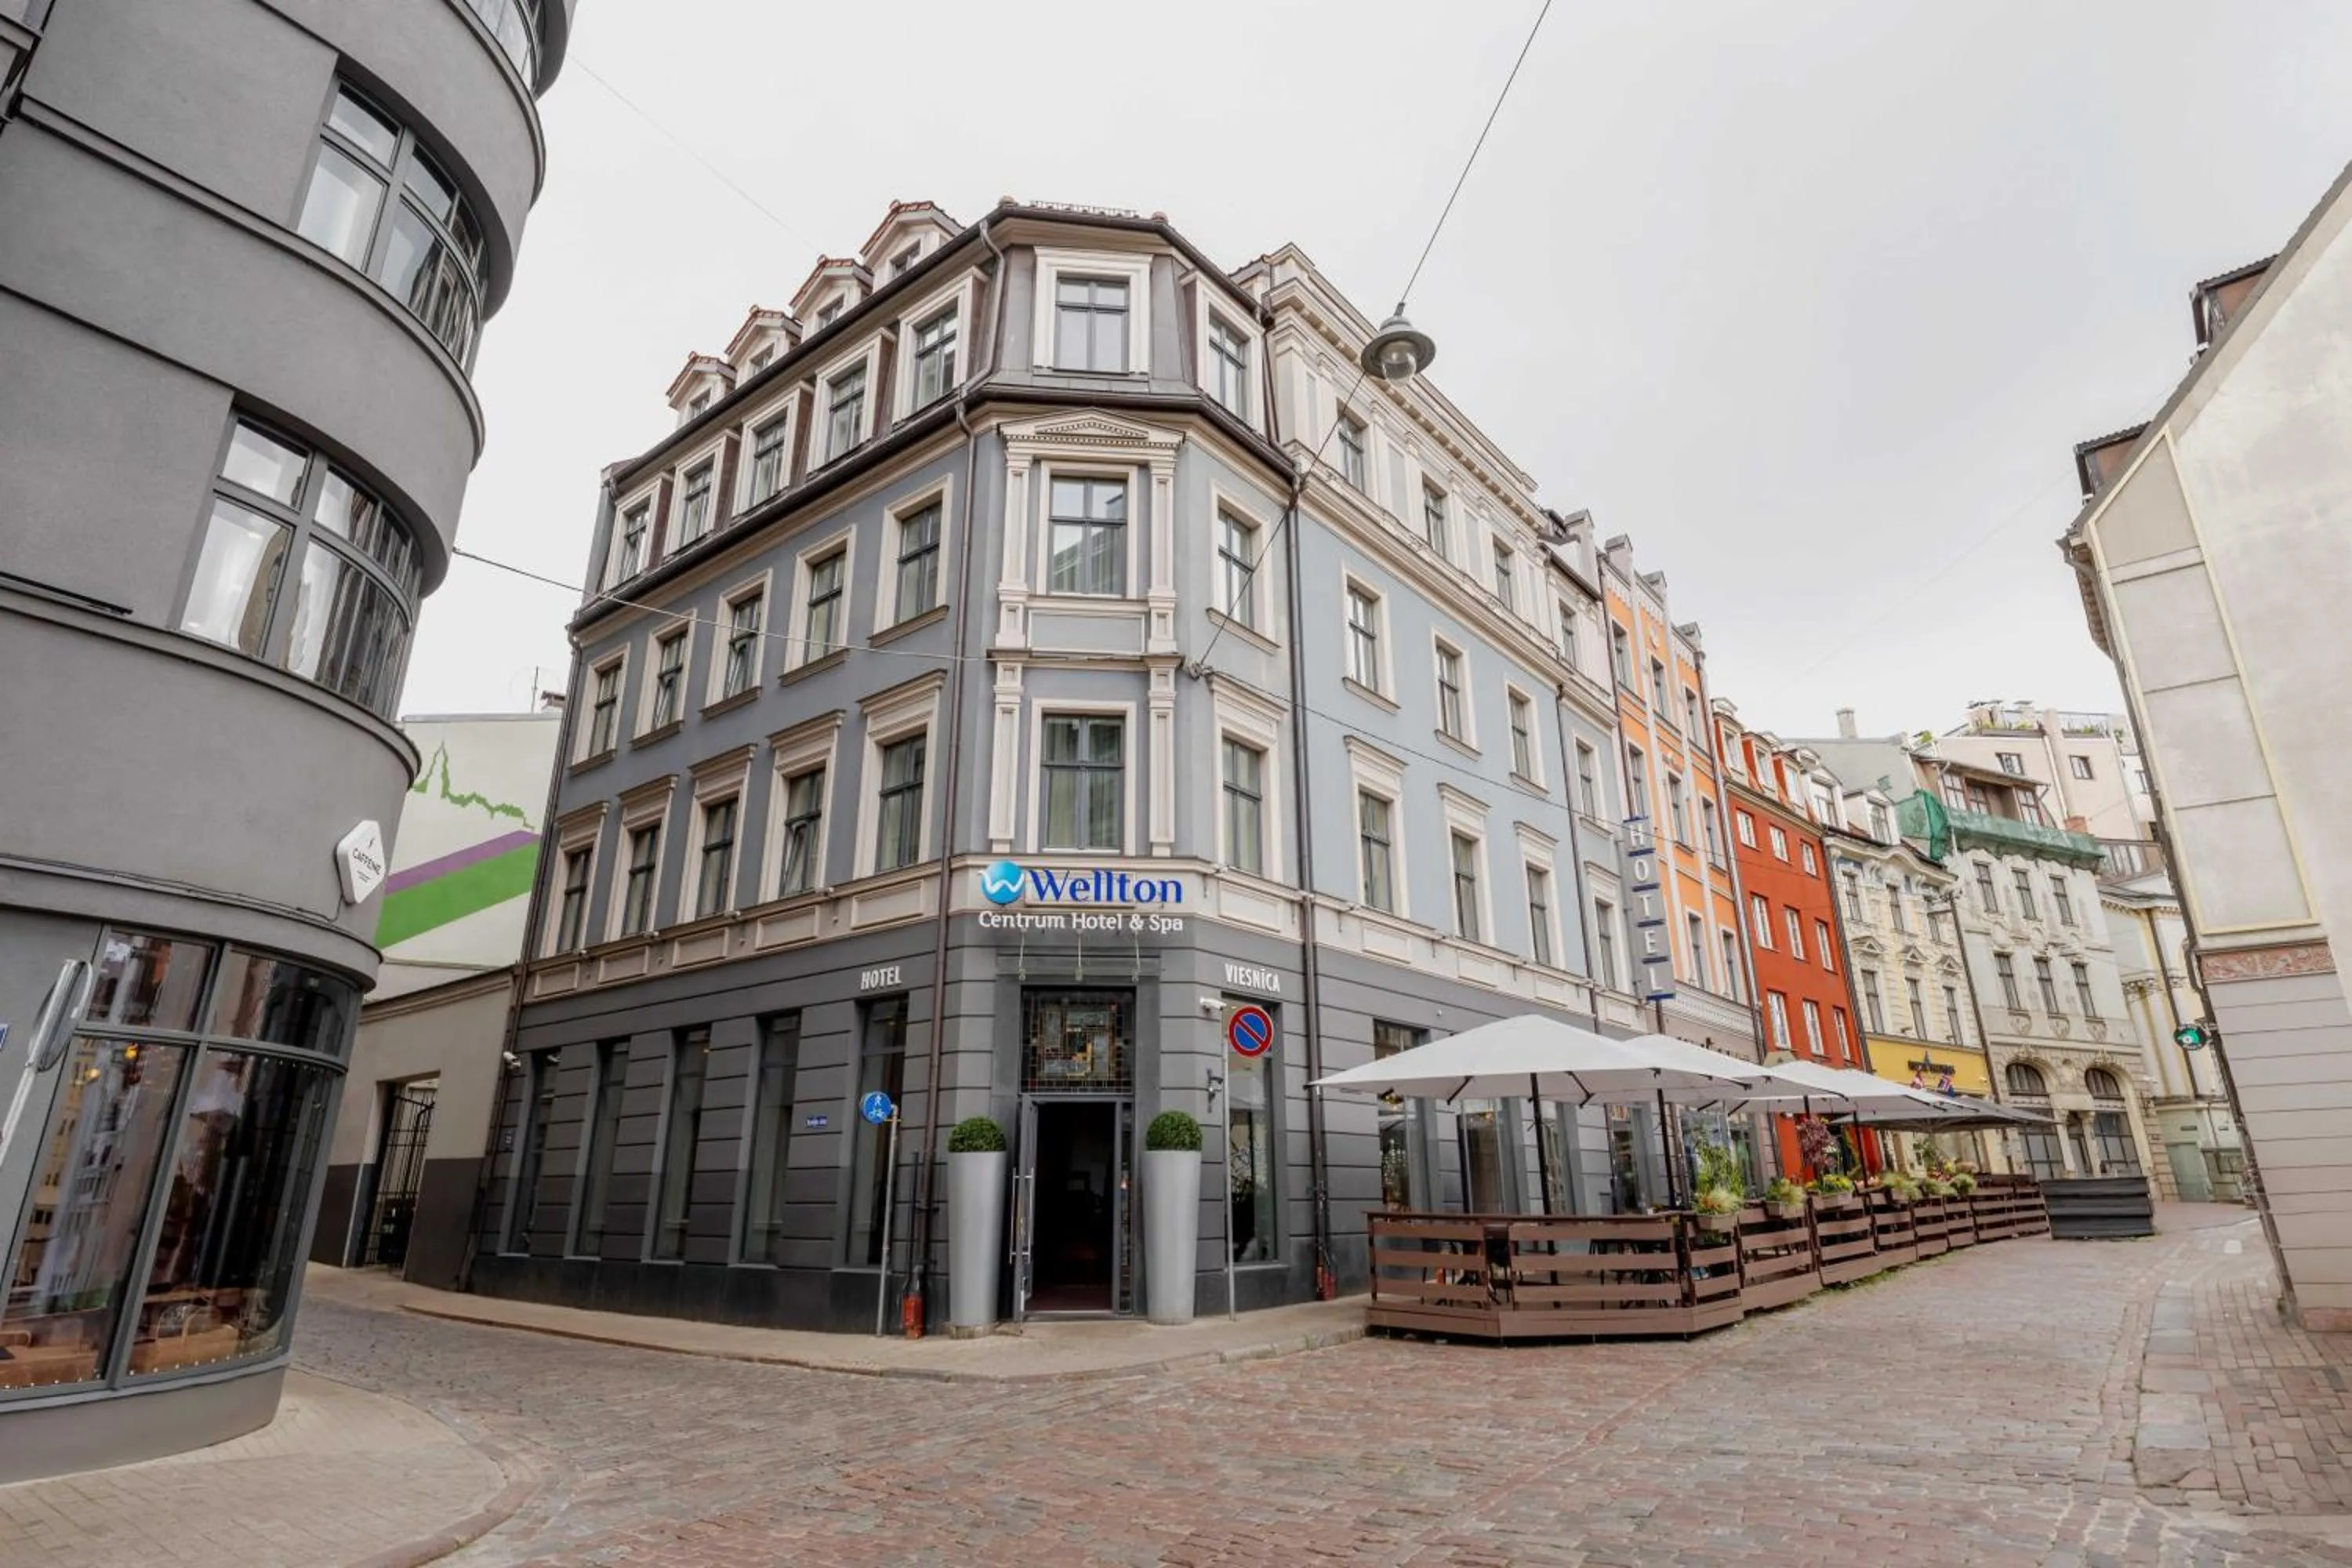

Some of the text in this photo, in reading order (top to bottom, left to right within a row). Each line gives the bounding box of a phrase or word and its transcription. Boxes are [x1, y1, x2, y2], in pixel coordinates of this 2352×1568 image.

[1029, 868, 1183, 904] Wellton
[978, 911, 1183, 934] Centrum Hotel & Spa
[1629, 824, 1664, 992] HOTEL
[860, 965, 902, 990] HOTEL
[1224, 963, 1281, 993] VIESNĪCA
